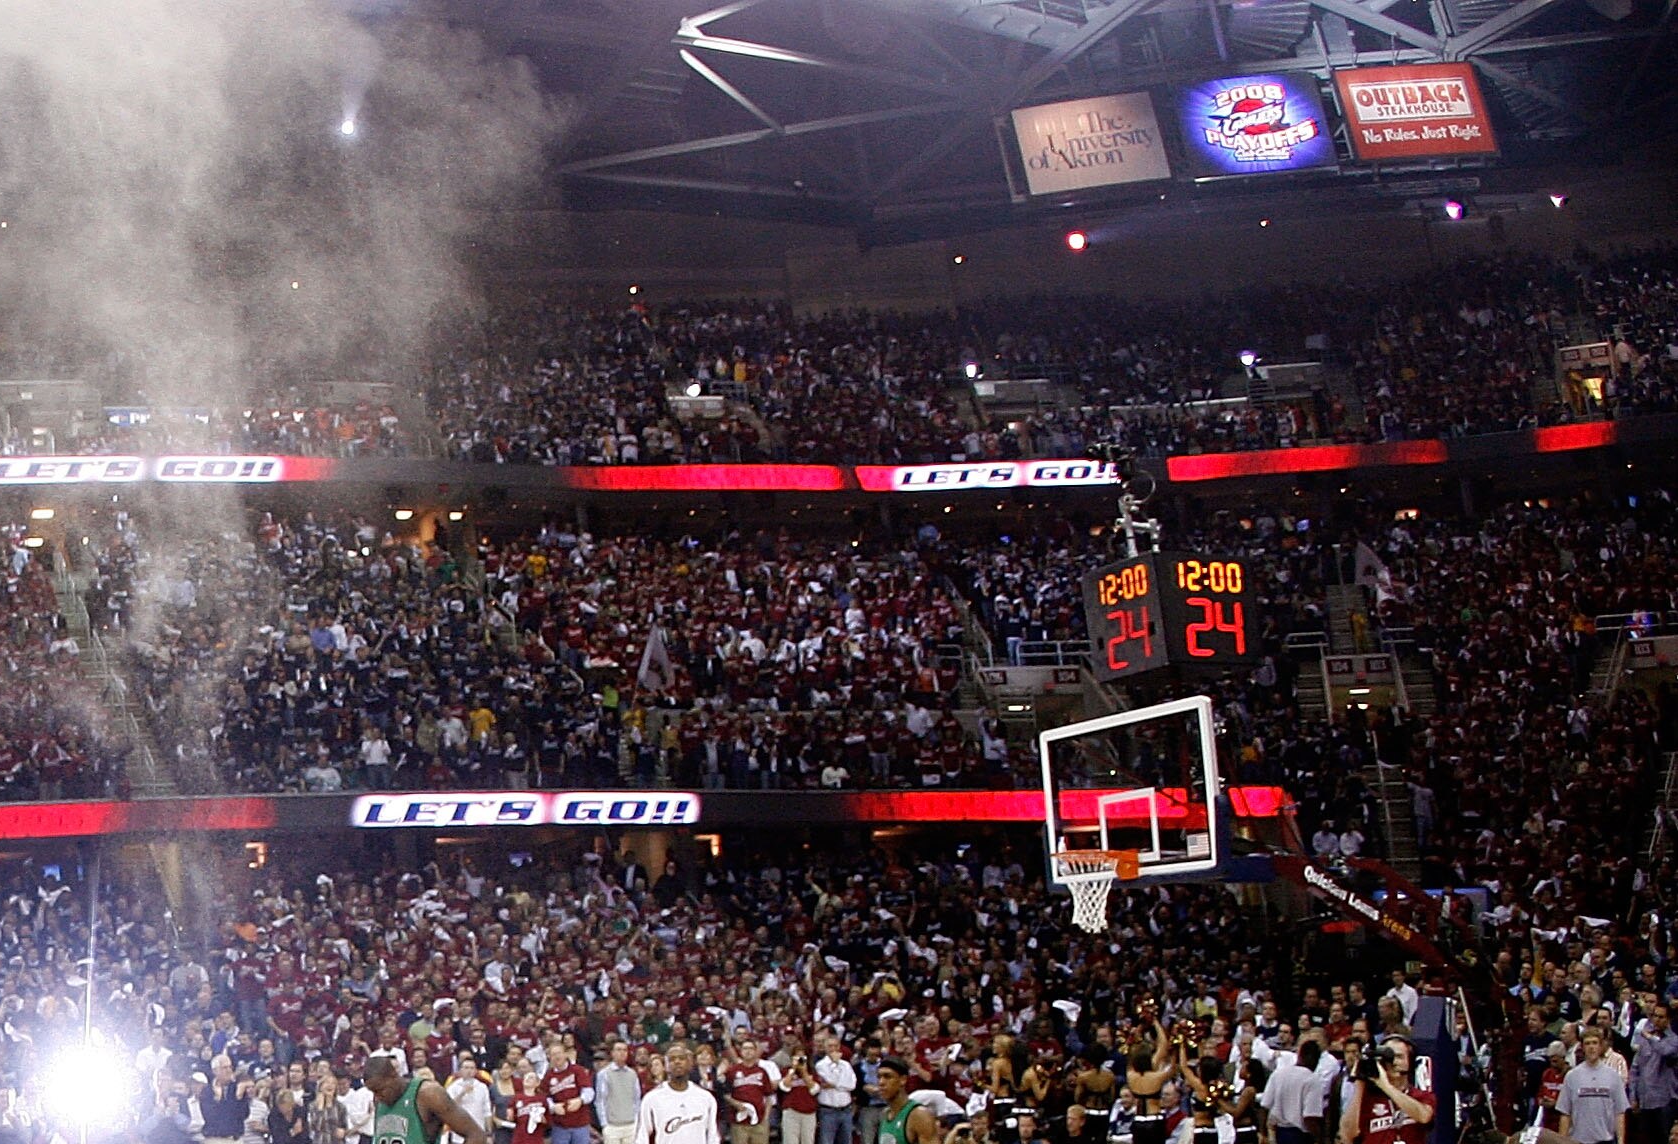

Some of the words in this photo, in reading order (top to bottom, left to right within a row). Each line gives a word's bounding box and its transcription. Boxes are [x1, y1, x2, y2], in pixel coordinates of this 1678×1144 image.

[1215, 83, 1286, 108] 2008
[1356, 83, 1466, 107] OUTBACK
[1376, 102, 1454, 117] STEAKHOUSE
[1046, 127, 1154, 155] University
[1203, 117, 1319, 150] PLAYOFFS
[1362, 128, 1382, 145] No
[1422, 125, 1448, 140] Just
[1028, 146, 1051, 170] of
[1054, 149, 1125, 172] Akron
[900, 466, 1017, 486] LET'S
[1098, 563, 1149, 607] 12:00
[1177, 560, 1243, 594] 12:00
[1105, 605, 1154, 671] 24
[1185, 597, 1247, 658] 24
[362, 799, 540, 825] LET'S
[562, 799, 692, 823] GO!!
